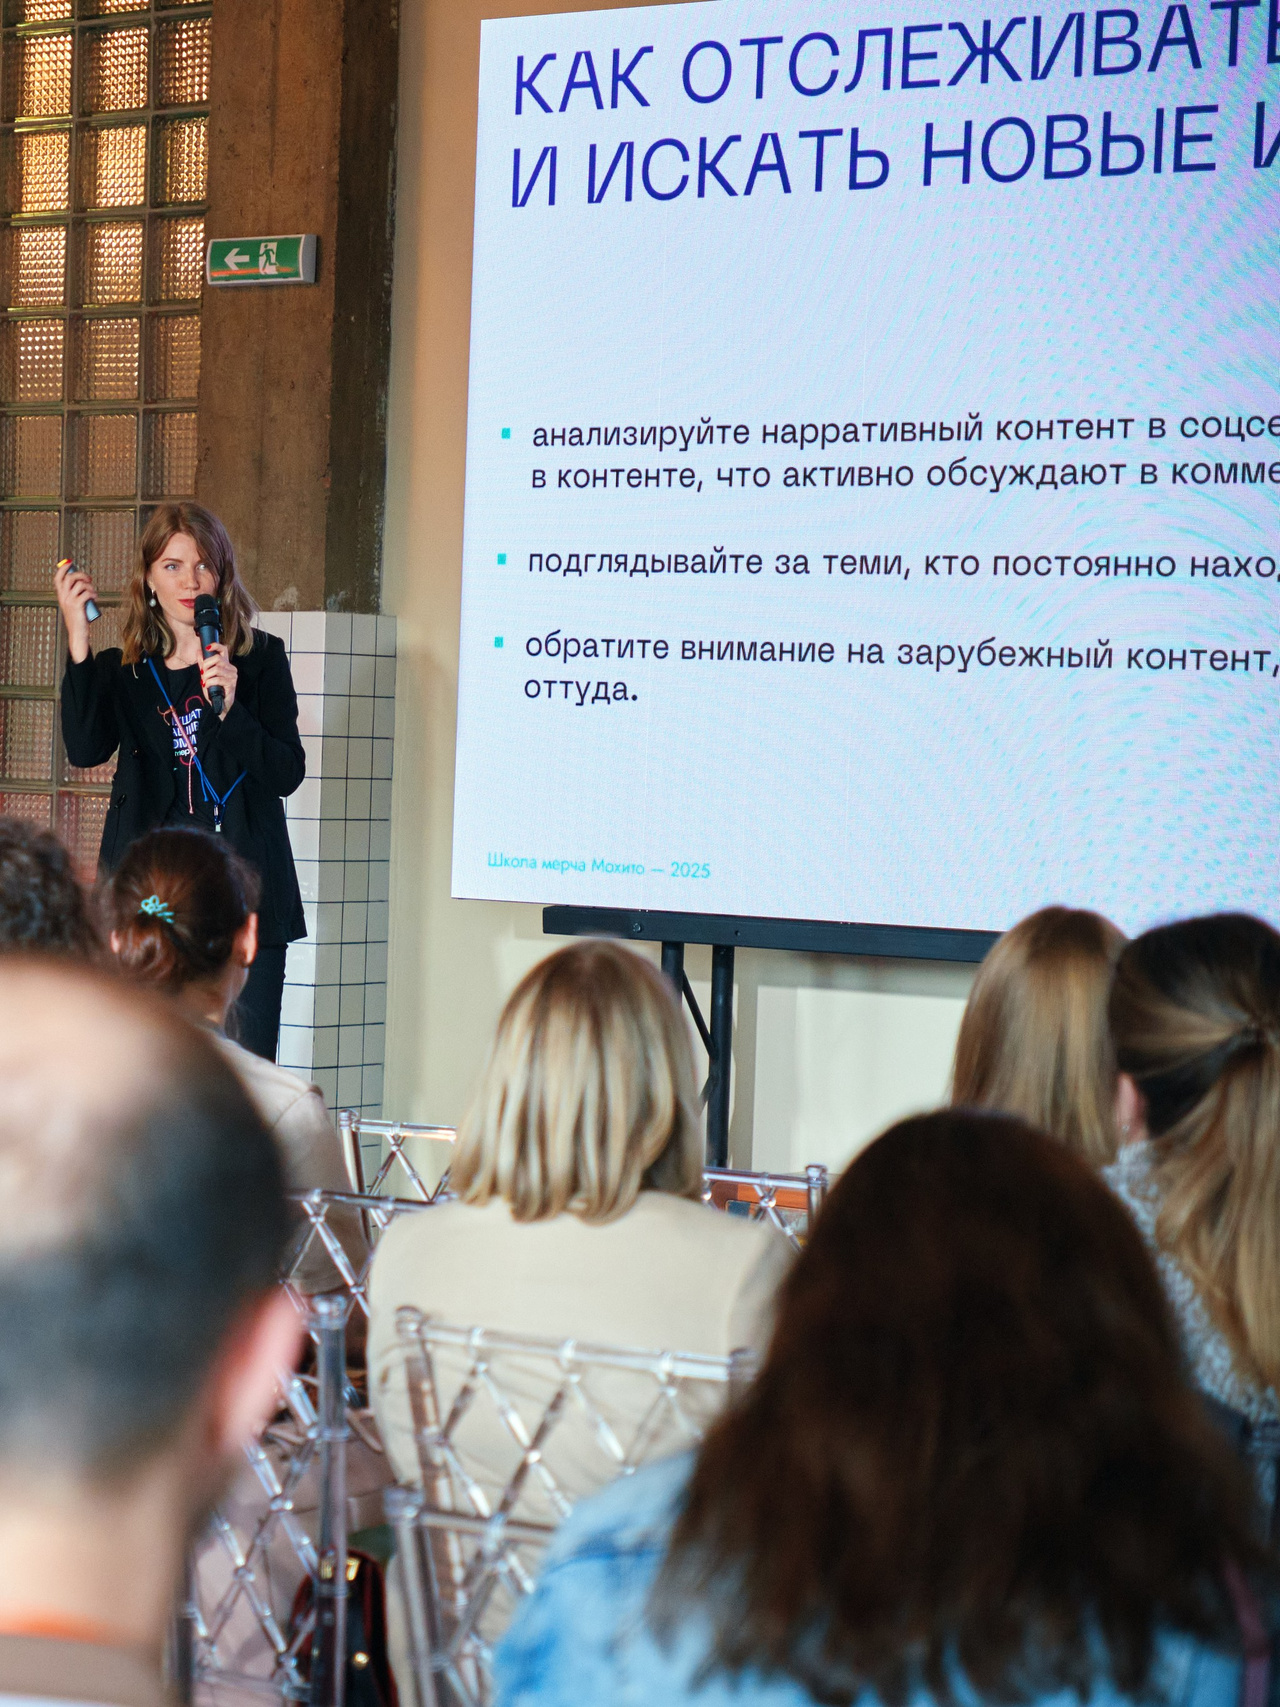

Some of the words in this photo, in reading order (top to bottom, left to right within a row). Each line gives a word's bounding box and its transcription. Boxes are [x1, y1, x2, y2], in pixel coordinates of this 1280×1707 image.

[514, 45, 654, 116] КАК
[682, 0, 1280, 104] ОТСЛЕЖИВАТ
[511, 145, 558, 208] И
[587, 127, 890, 204] ИСКАТЬ
[923, 103, 1220, 187] НОВЫЕ
[532, 416, 750, 452] анализируйте
[762, 411, 983, 451] нарративный
[996, 418, 1135, 441] контент
[1148, 417, 1167, 439] в
[532, 469, 547, 489] в
[557, 467, 703, 493] контенте,
[716, 465, 771, 489] что
[782, 465, 914, 488] активно
[926, 456, 1127, 494] обсуждают
[1140, 463, 1158, 485] в
[529, 545, 763, 578] подглядывайте
[775, 554, 811, 575] за
[822, 554, 910, 581] теми,
[924, 555, 980, 576] кто
[993, 555, 1177, 579] постоянно
[1190, 555, 1280, 583] нахо
[525, 629, 669, 664] обратите
[681, 640, 835, 663] внимание
[847, 643, 885, 664] на
[897, 636, 1113, 674] зарубежный
[1127, 648, 1279, 678] контент,
[524, 679, 638, 707] оттуда.
[487, 851, 537, 870] Школа
[541, 860, 586, 875] мерча
[591, 858, 645, 875] Мохито
[670, 861, 711, 879] 2025
